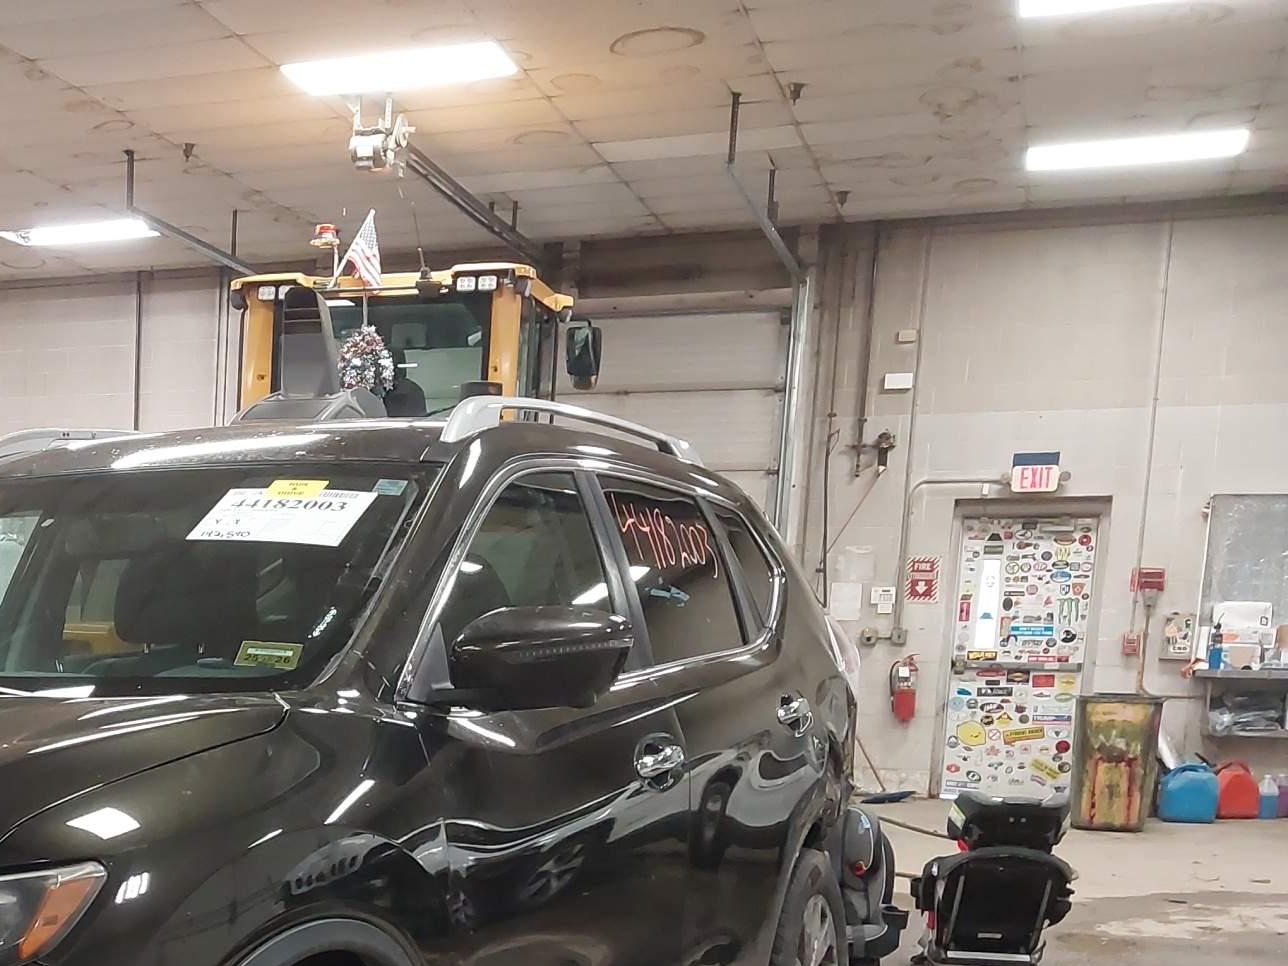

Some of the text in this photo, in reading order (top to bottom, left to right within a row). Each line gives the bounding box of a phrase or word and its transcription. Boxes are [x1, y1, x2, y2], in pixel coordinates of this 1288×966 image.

[1020, 466, 1053, 489] EXIT
[231, 498, 349, 512] 44182003
[611, 493, 719, 579] 44182003
[914, 562, 932, 571] FIRE
[274, 655, 291, 664] 26
